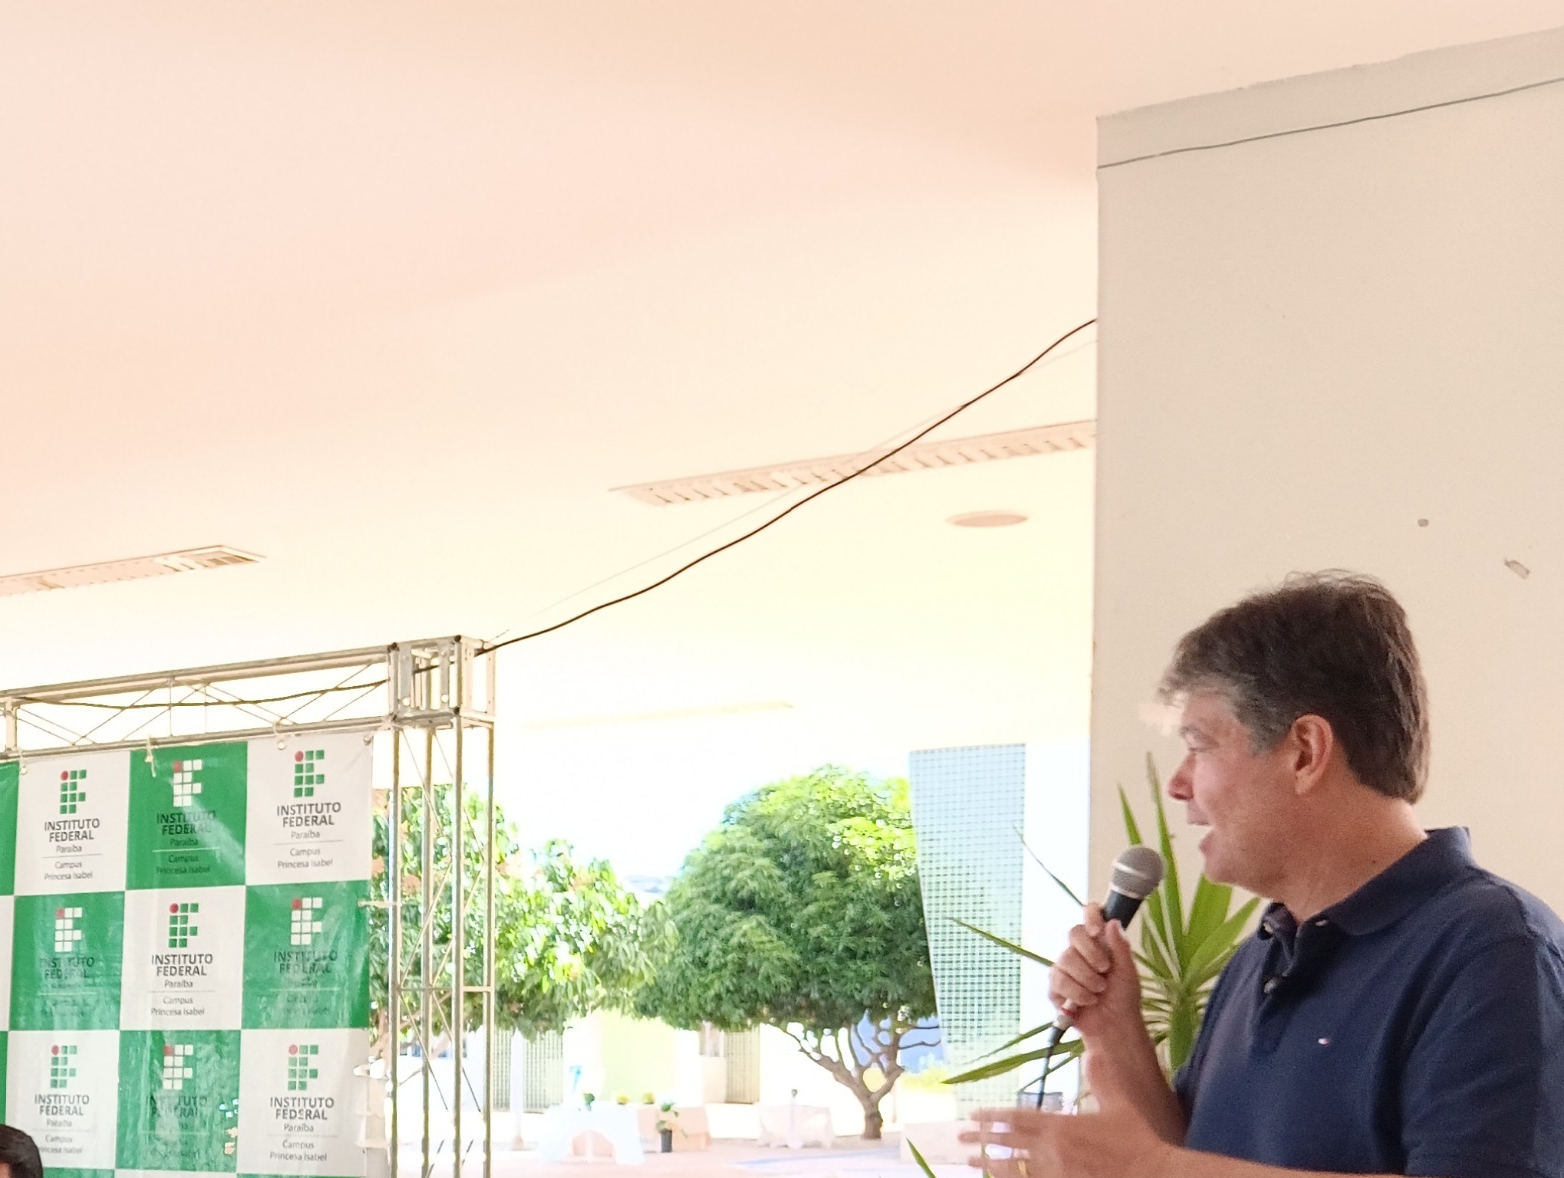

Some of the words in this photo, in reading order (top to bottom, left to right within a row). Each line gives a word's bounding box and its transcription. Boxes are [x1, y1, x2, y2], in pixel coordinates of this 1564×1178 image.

[277, 802, 341, 816] INSTITUTO
[44, 818, 100, 831] INSTITUTO
[283, 814, 335, 828] FEDERAL
[49, 829, 94, 842] FEDERAL
[291, 829, 321, 839] Paraíba
[56, 844, 82, 853] Paraíba
[290, 846, 321, 859] Campus
[55, 859, 82, 871] Campus
[168, 853, 197, 866] Campus
[278, 859, 310, 869] Princesa
[45, 871, 72, 880] Princesa
[151, 953, 213, 965] INSTITUTO
[157, 965, 207, 976] FEDERAL
[164, 979, 193, 988] Paraíba
[163, 996, 193, 1007] Campus
[151, 1008, 182, 1016] Princesa
[184, 1007, 206, 1015] Isabel
[34, 1094, 90, 1104] INSTITUTO
[270, 1097, 335, 1108] INSTITUTO
[39, 1105, 84, 1115] FEDERAL
[275, 1109, 328, 1120] FEDERAL
[283, 1124, 314, 1132] Paraíba
[282, 1141, 314, 1152] Campus
[270, 1153, 302, 1161] Princesa
